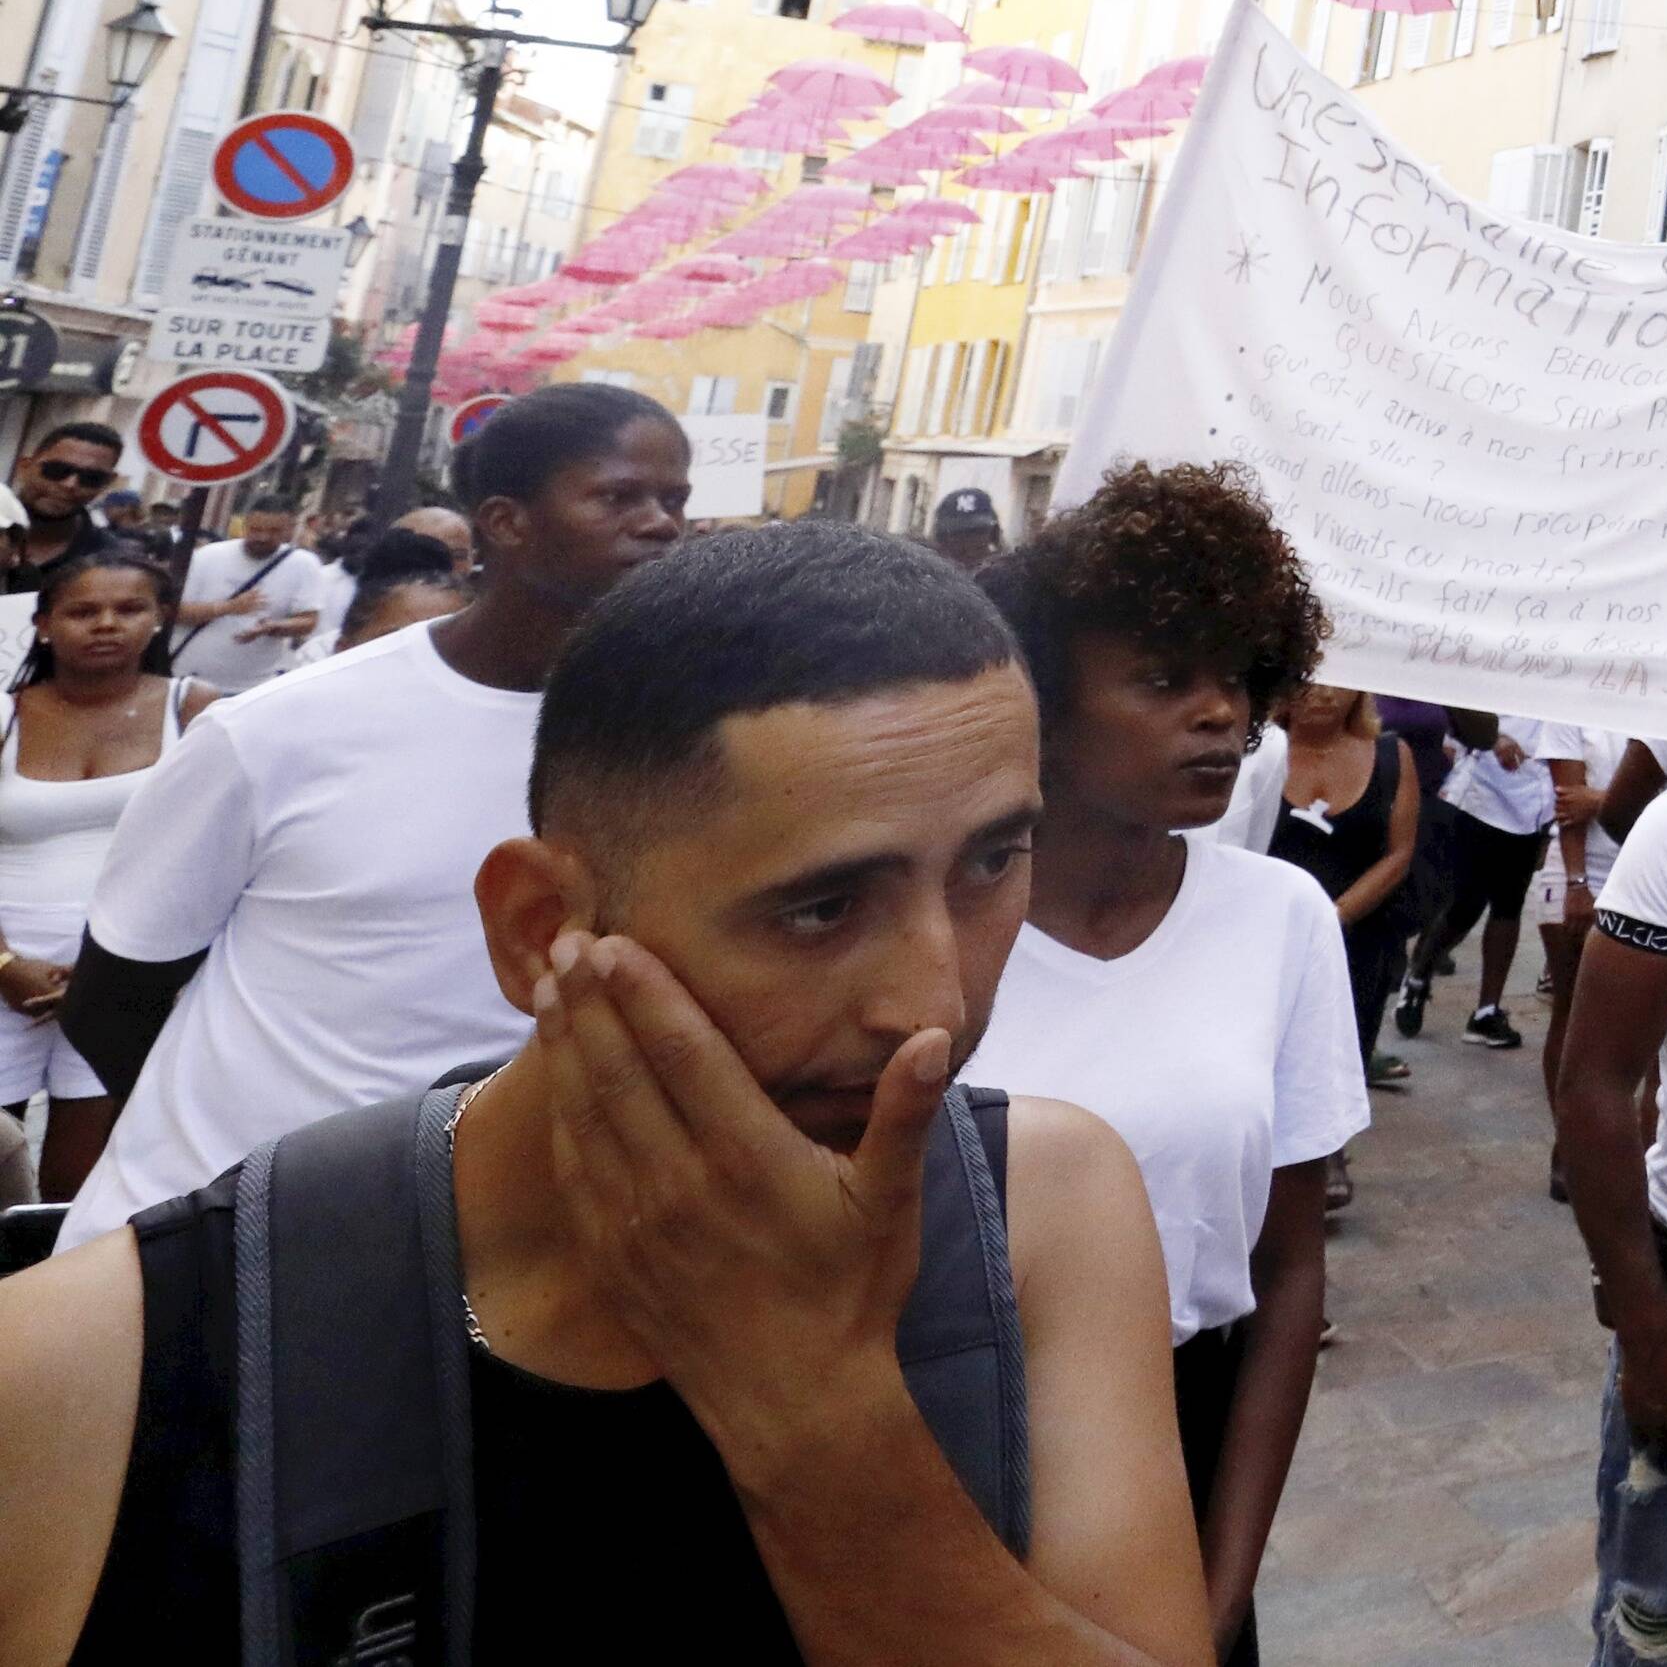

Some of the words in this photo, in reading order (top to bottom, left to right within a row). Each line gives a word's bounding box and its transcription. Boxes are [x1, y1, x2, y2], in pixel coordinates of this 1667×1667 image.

[190, 223, 344, 250] STATIONNEMENT
[169, 315, 223, 336] SUR
[237, 320, 318, 344] TOUTE
[173, 341, 204, 359] LA
[215, 343, 300, 366] PLACE
